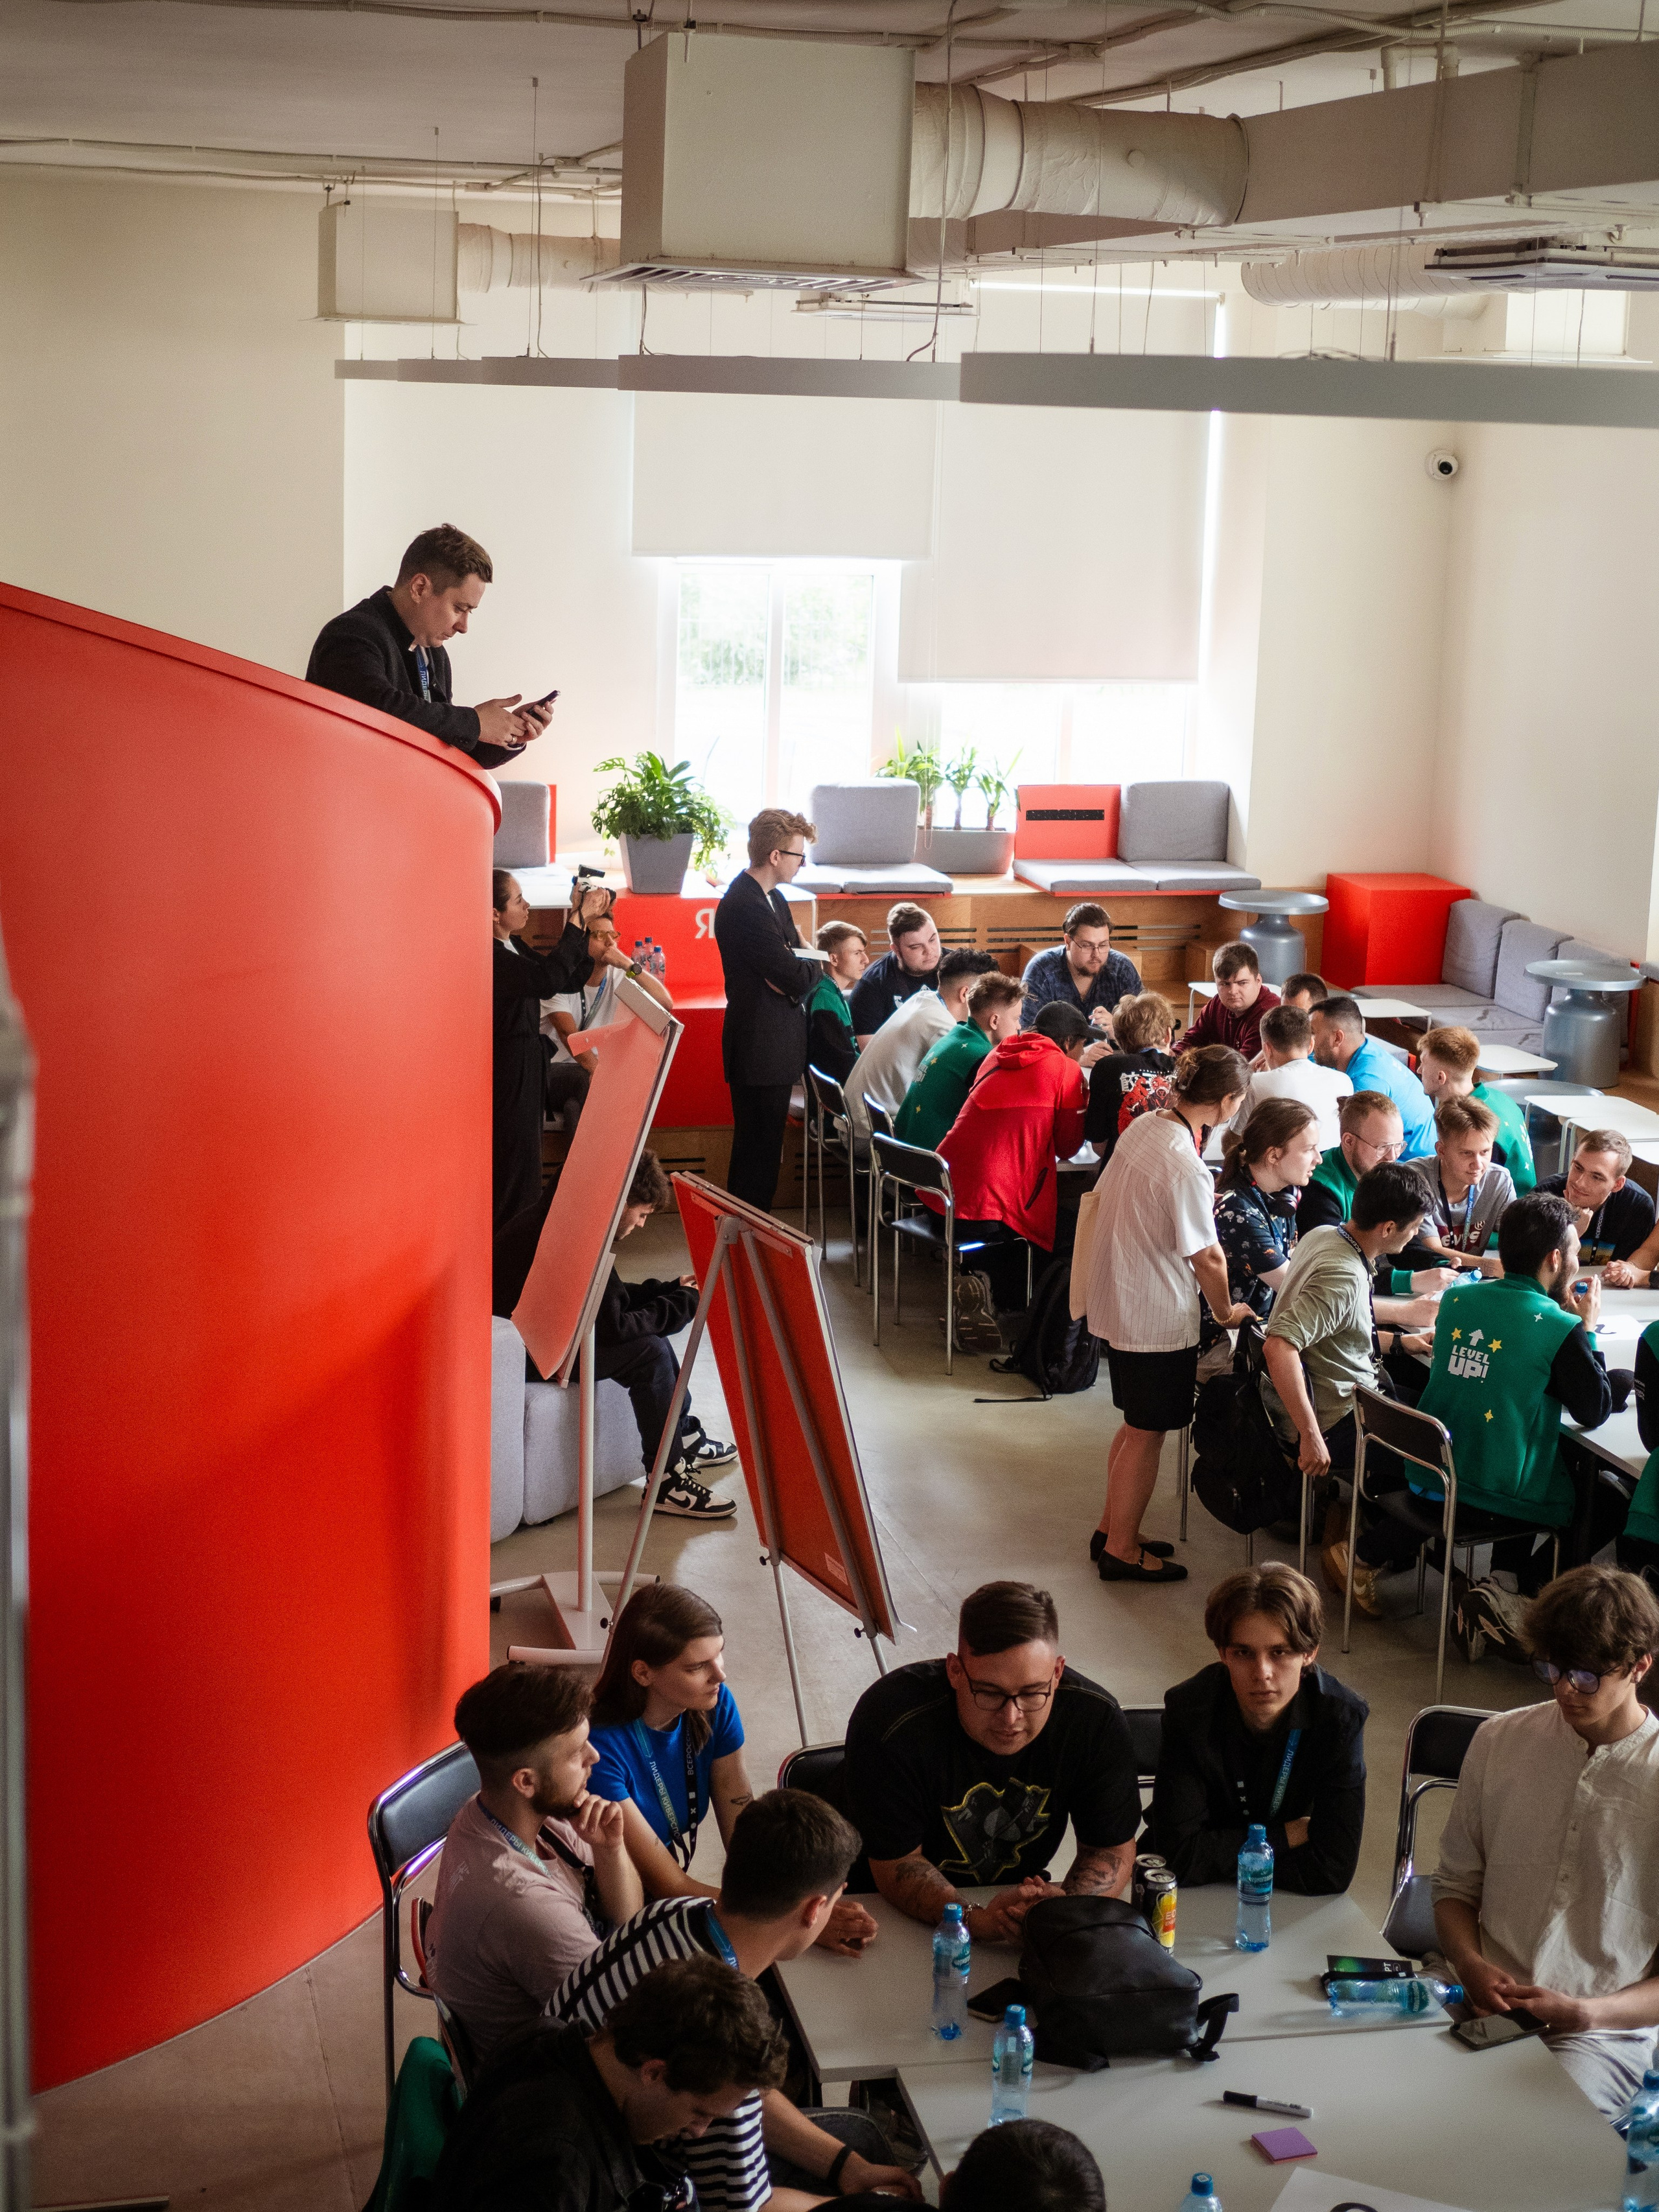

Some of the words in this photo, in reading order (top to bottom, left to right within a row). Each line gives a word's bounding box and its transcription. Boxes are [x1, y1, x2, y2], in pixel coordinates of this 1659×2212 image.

[1447, 1355, 1489, 1384] UP!
[1452, 1345, 1490, 1365] LEVEL
[649, 1761, 665, 1798] ЛИДЕРЫ
[662, 1796, 681, 1839] КИБЕРСПО
[491, 1819, 522, 1848] ЛИДЕРЫ
